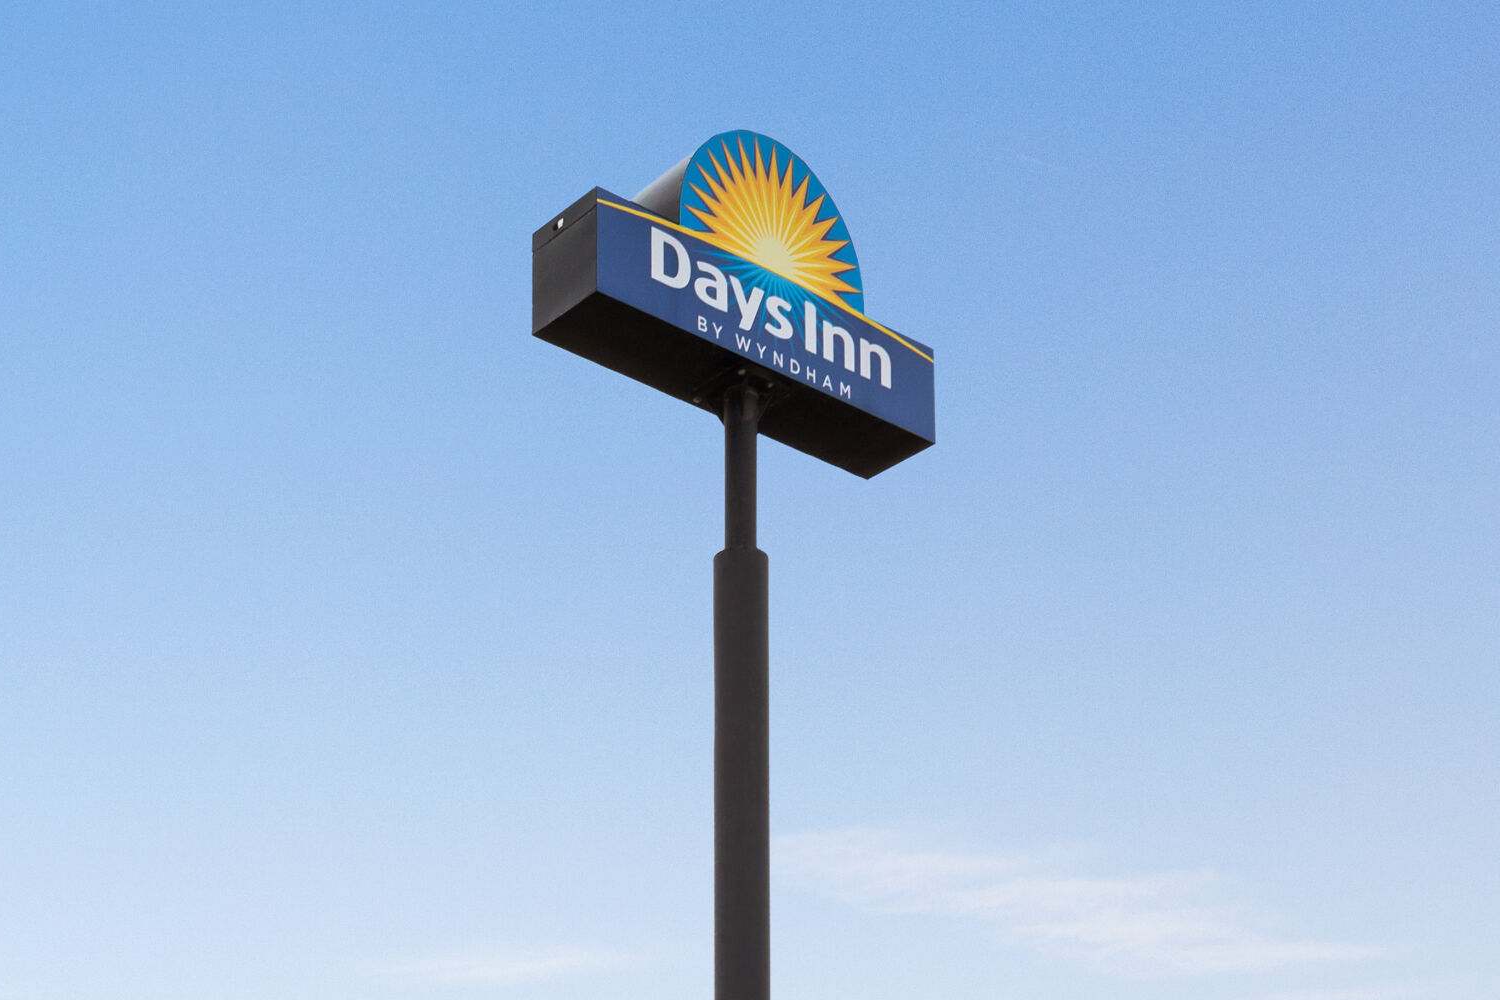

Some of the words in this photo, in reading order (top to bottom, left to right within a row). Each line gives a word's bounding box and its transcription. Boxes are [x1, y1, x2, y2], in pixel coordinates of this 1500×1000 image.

[650, 225, 793, 340] Days
[804, 300, 892, 390] Inn
[697, 315, 723, 339] BY
[735, 333, 851, 399] WYNDHAM
